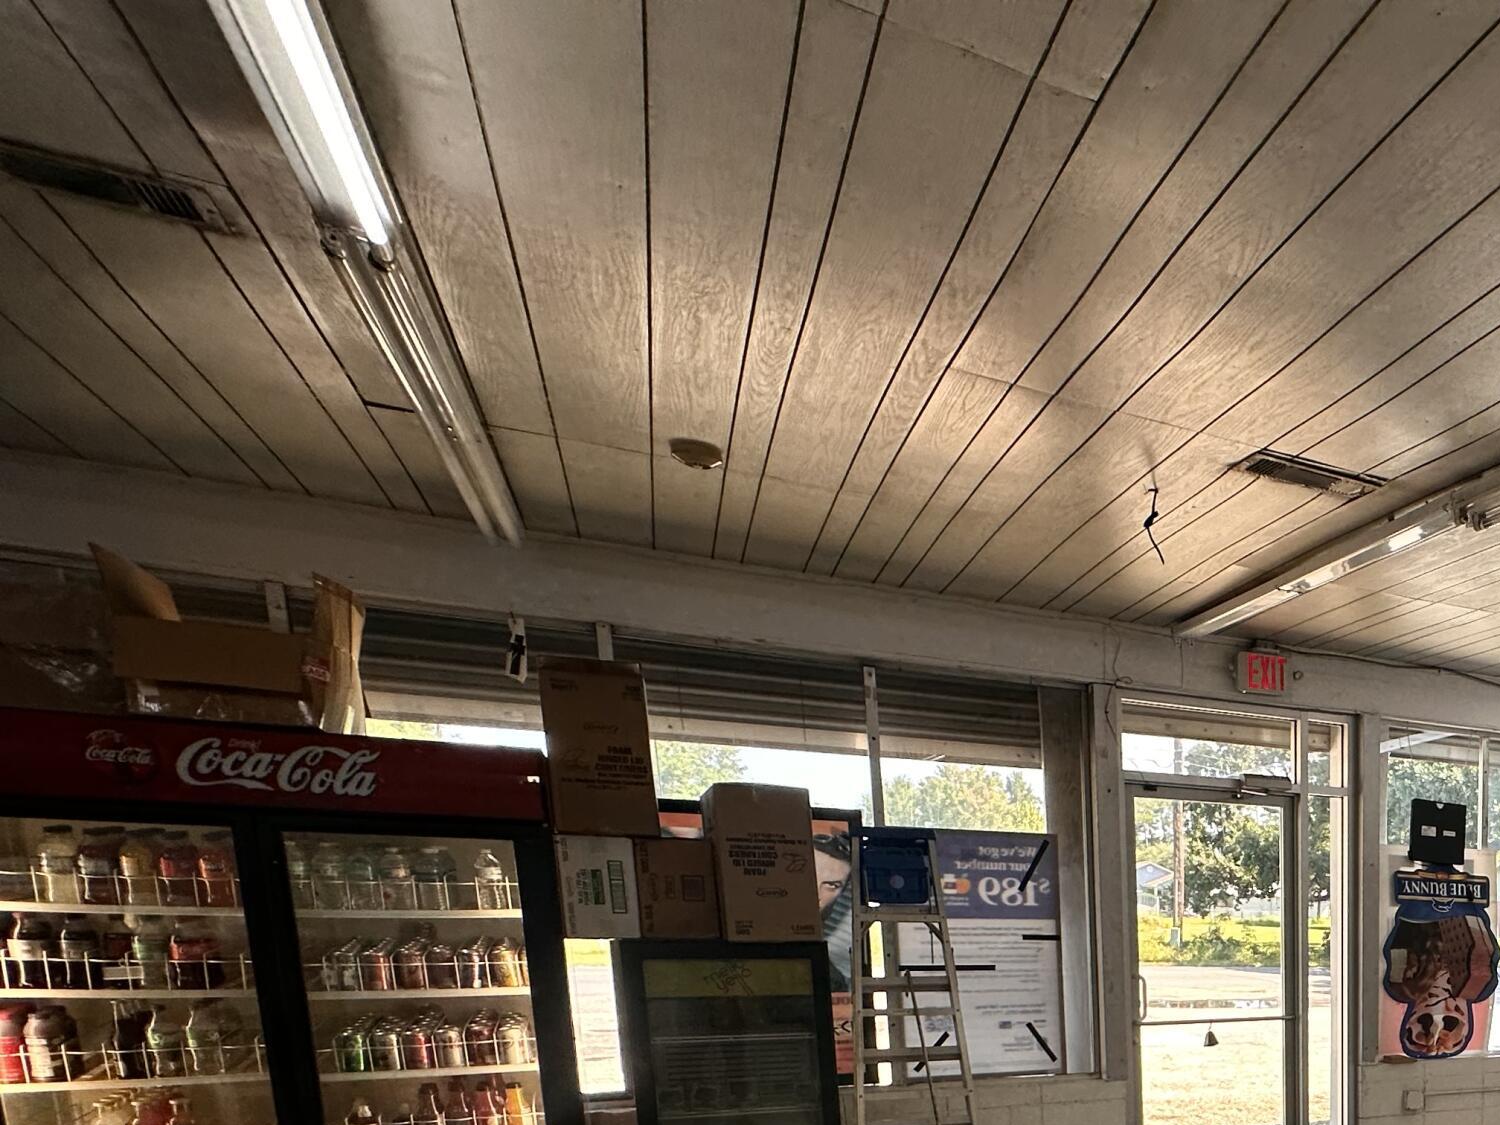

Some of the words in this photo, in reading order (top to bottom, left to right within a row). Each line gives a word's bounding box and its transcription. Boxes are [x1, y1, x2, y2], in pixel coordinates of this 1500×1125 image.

[1248, 652, 1287, 691] EXIT
[85, 745, 154, 766] Coca-Cola
[176, 738, 380, 797] Coca-Cola
[1402, 880, 1448, 897] BUNNY
